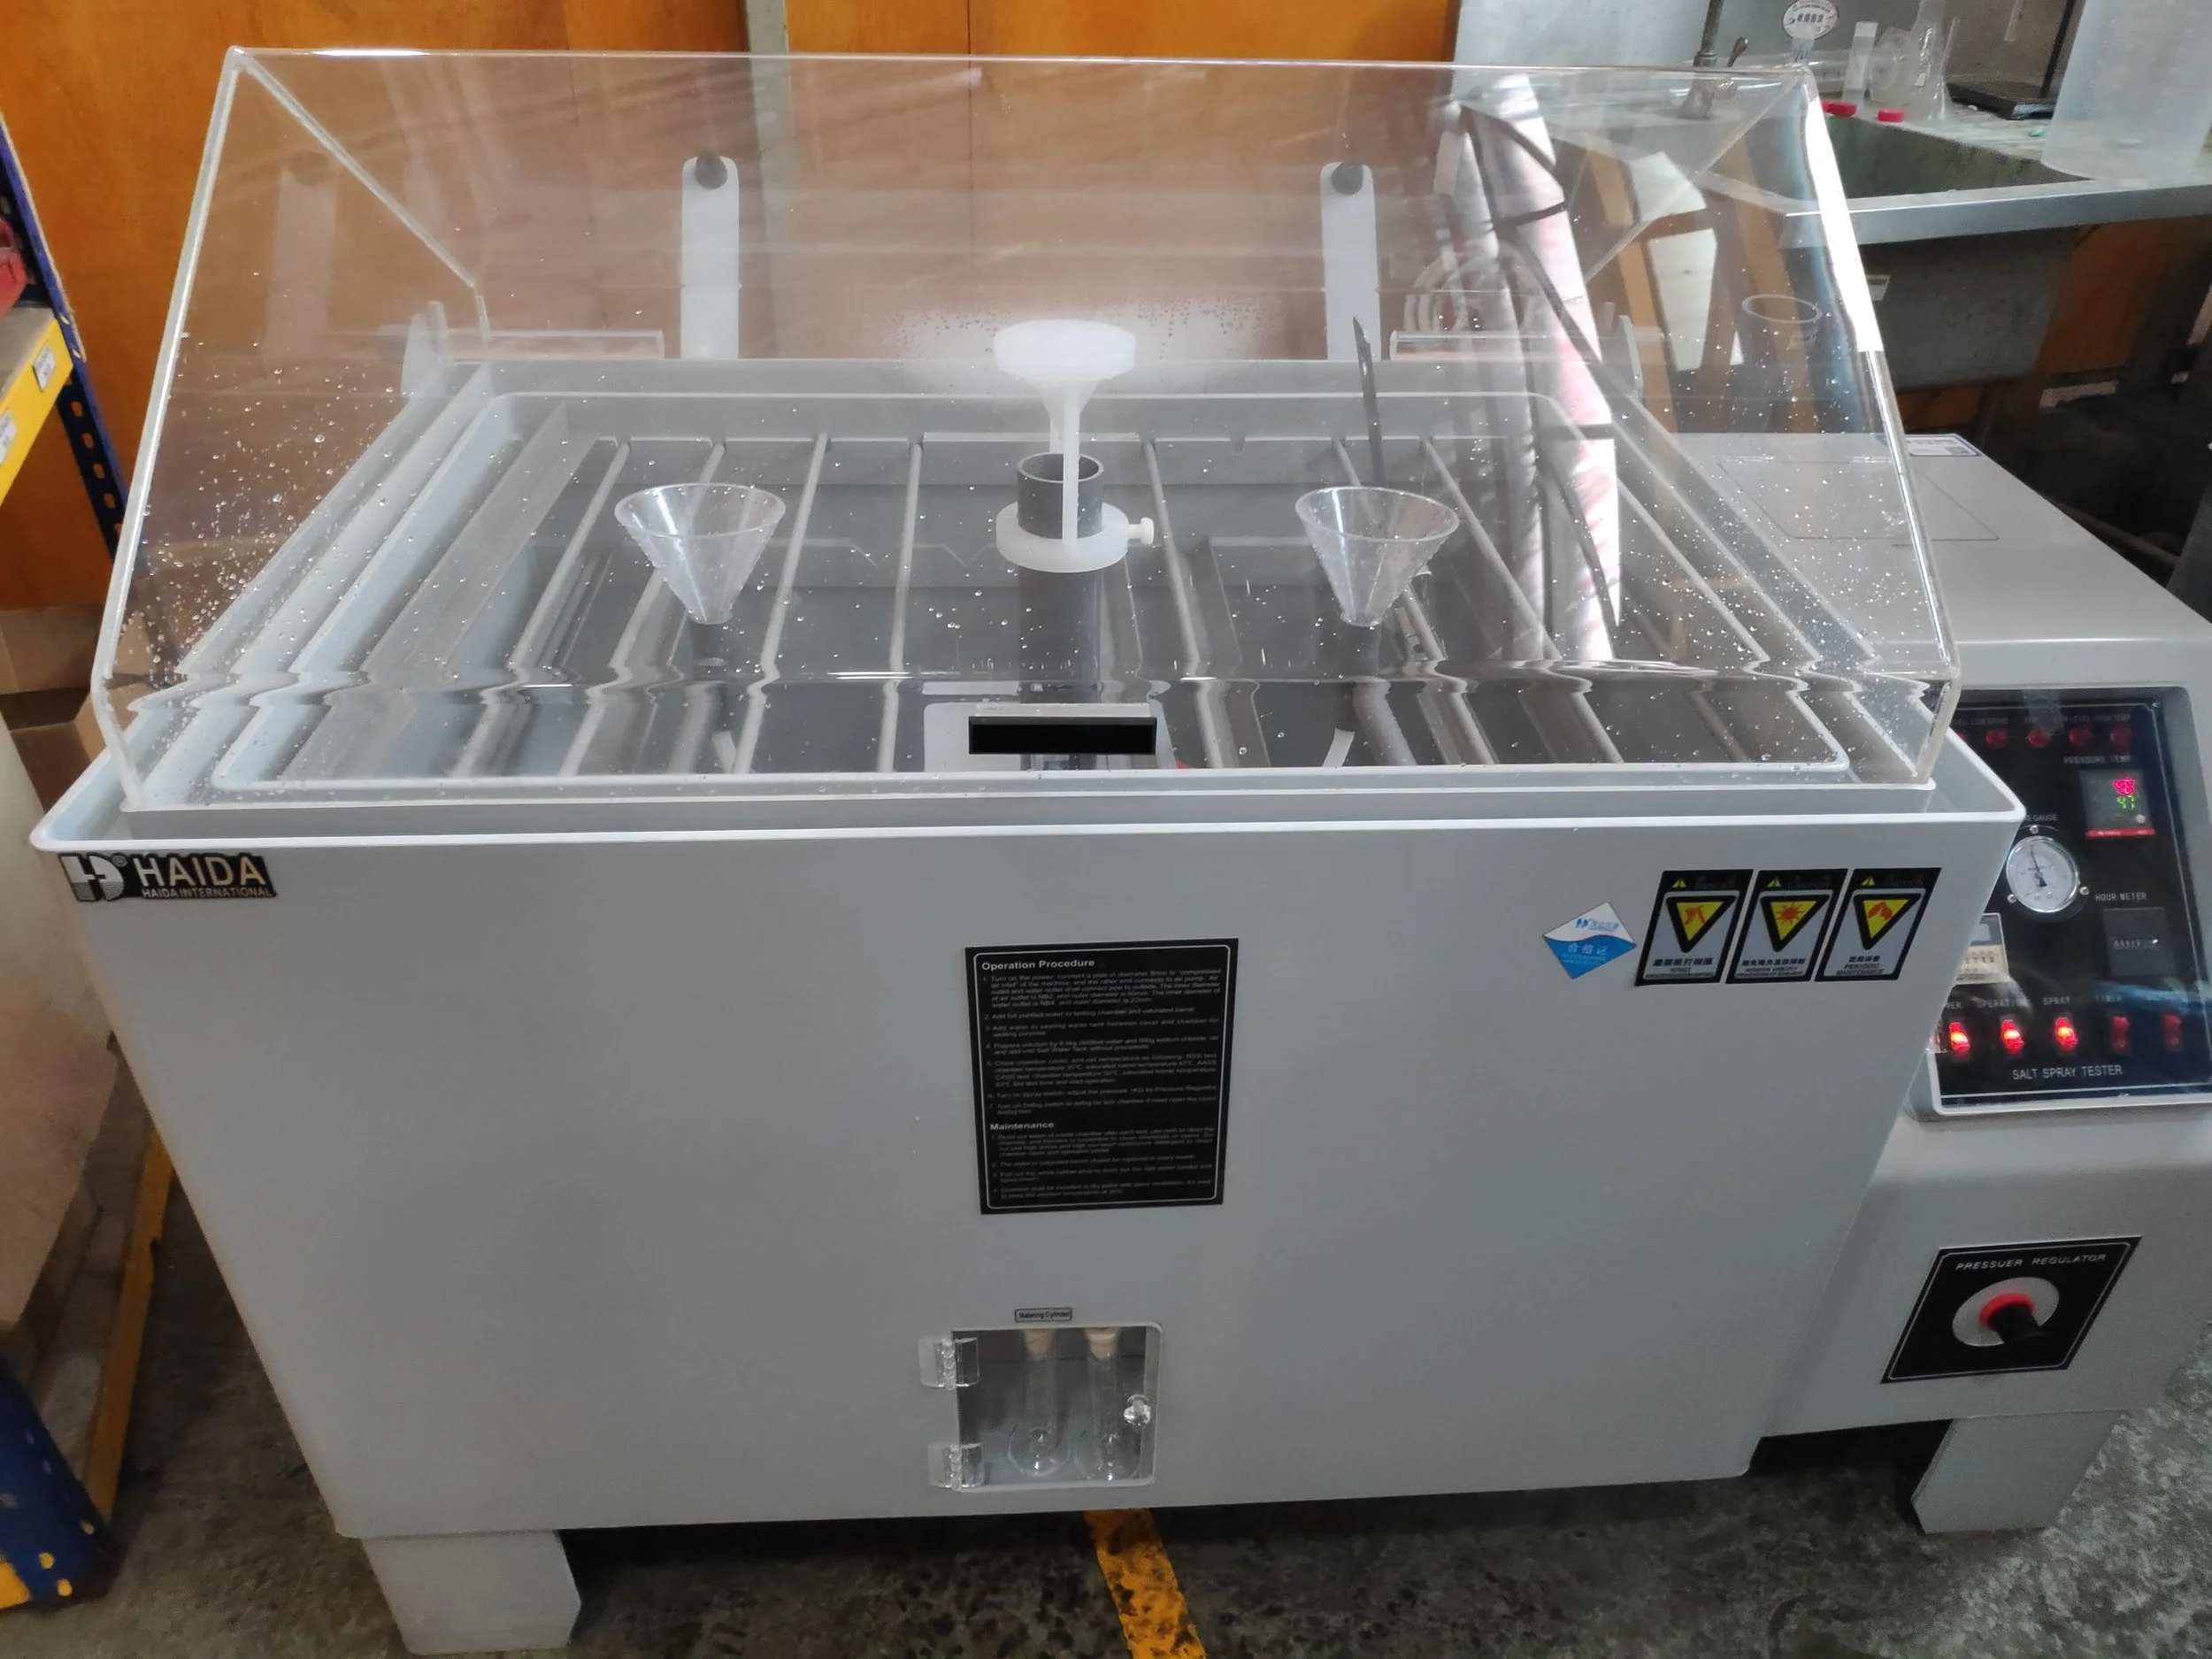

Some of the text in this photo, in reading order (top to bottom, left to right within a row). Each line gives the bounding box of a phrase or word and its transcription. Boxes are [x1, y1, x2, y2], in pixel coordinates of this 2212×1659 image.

[133, 856, 267, 887] HAIDA
[142, 887, 273, 900] HAIDA INTERNATIONAL
[2095, 892, 2147, 902] HOUR METER
[981, 960, 1095, 972] Operation Procedure
[2042, 995, 2071, 1006] SPRAY
[2012, 1064, 2124, 1080] SALT SPRAY TESTER
[989, 1122, 1055, 1131] Maintenance
[1955, 1253, 2108, 1271] PRESSUER REGULATOR
